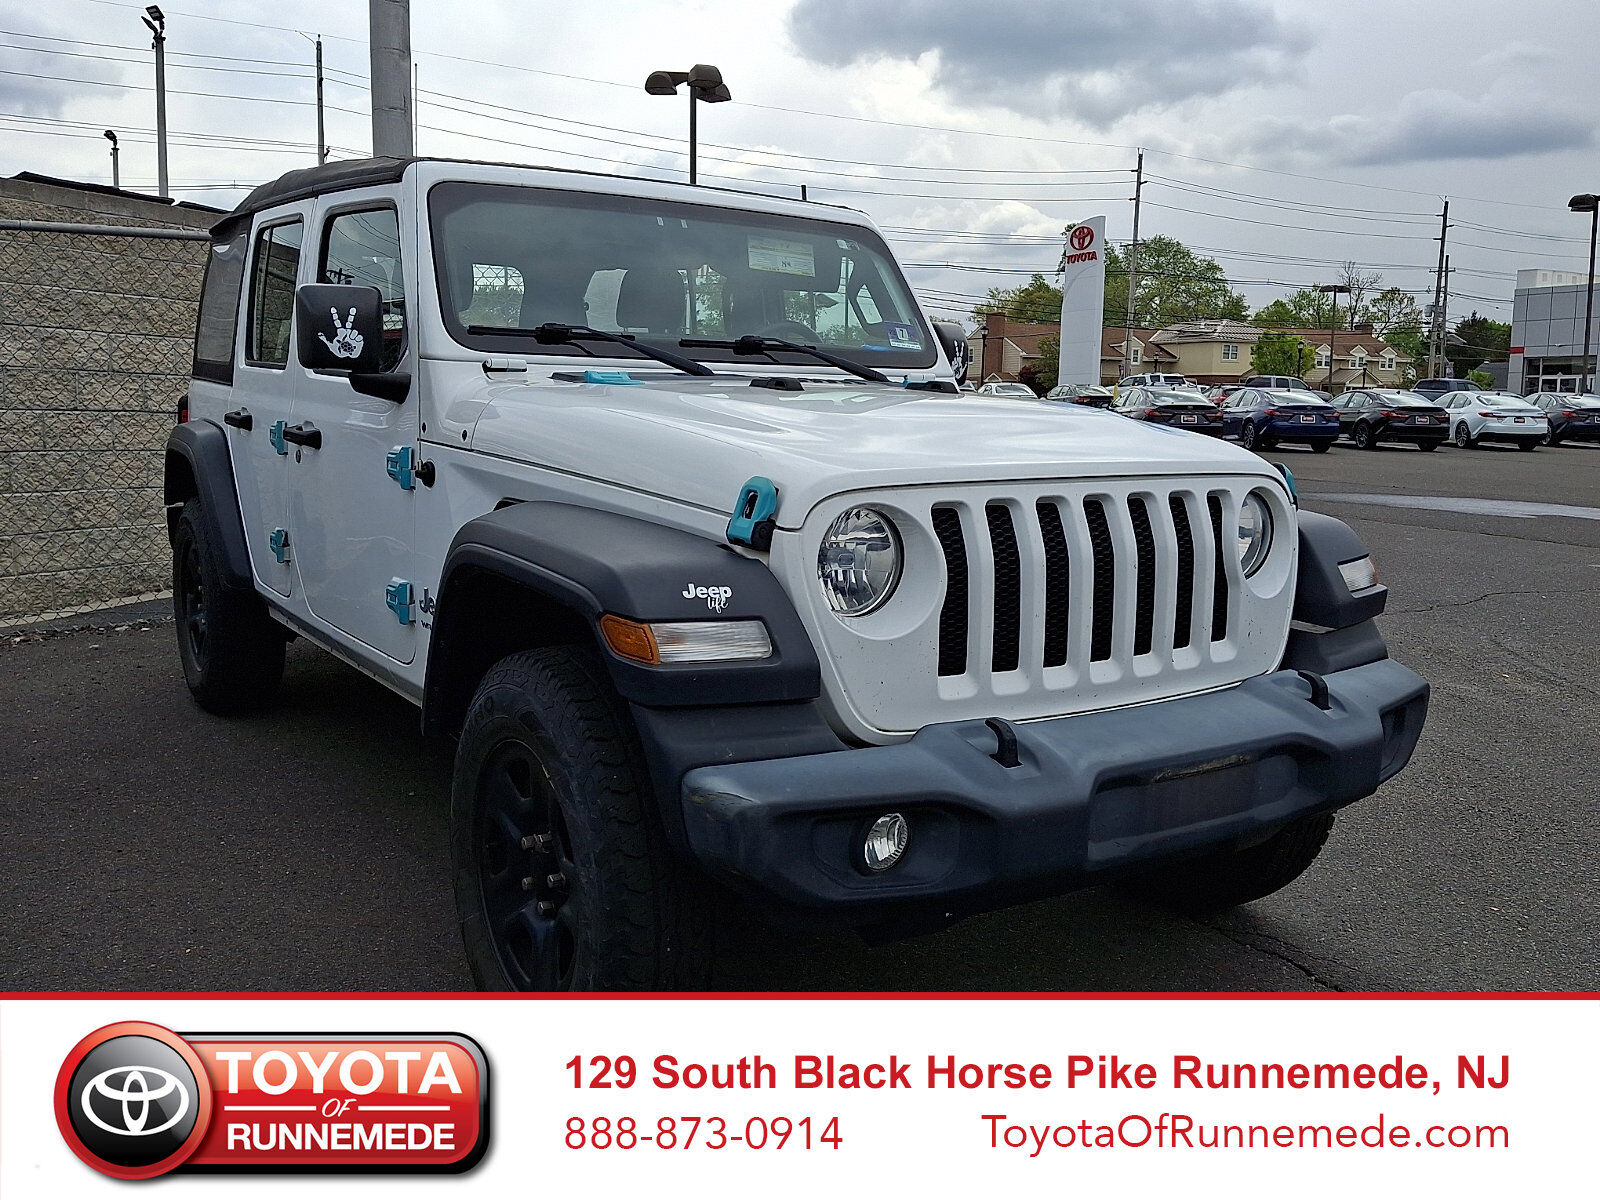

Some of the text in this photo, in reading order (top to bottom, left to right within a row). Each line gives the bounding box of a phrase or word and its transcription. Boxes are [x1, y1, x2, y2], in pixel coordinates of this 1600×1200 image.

[1065, 251, 1097, 264] TOYOTA
[682, 583, 732, 603] Jeep
[708, 596, 729, 614] life
